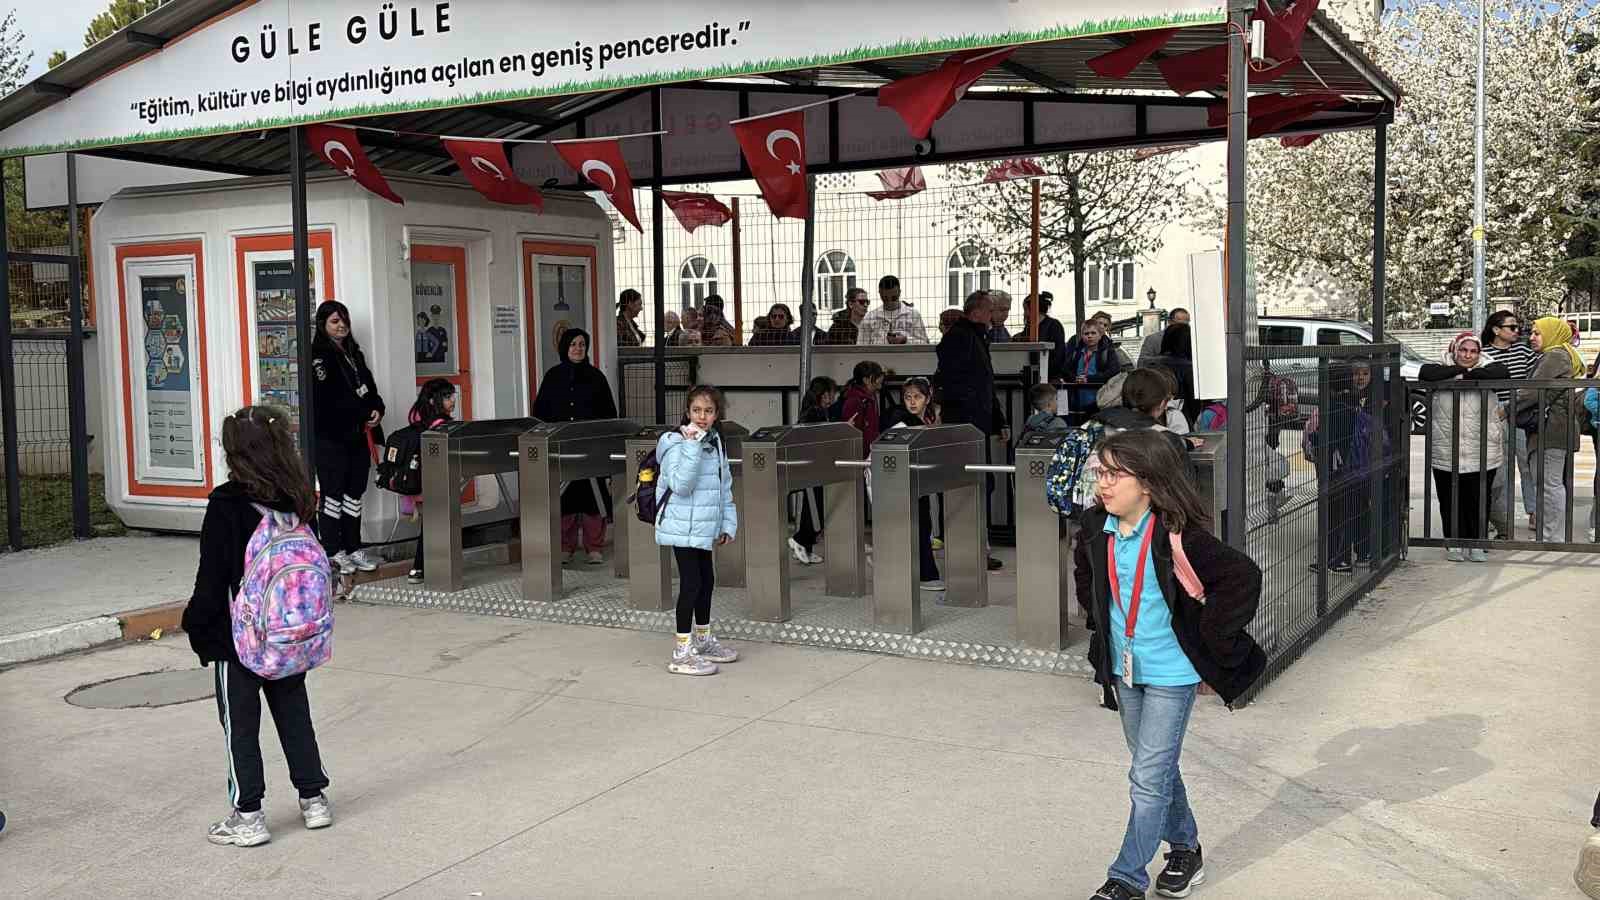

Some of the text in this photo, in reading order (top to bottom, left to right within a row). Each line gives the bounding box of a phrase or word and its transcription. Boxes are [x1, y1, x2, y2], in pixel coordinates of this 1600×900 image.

[231, 2, 450, 63] GÜLE GÜLE
[198, 91, 248, 113] kültür
[250, 90, 271, 105] ve
[274, 76, 312, 106] bilgi
[315, 66, 427, 102] aydınlığına
[431, 57, 495, 88] açılan
[499, 54, 526, 73] en
[530, 40, 594, 78] geniş
